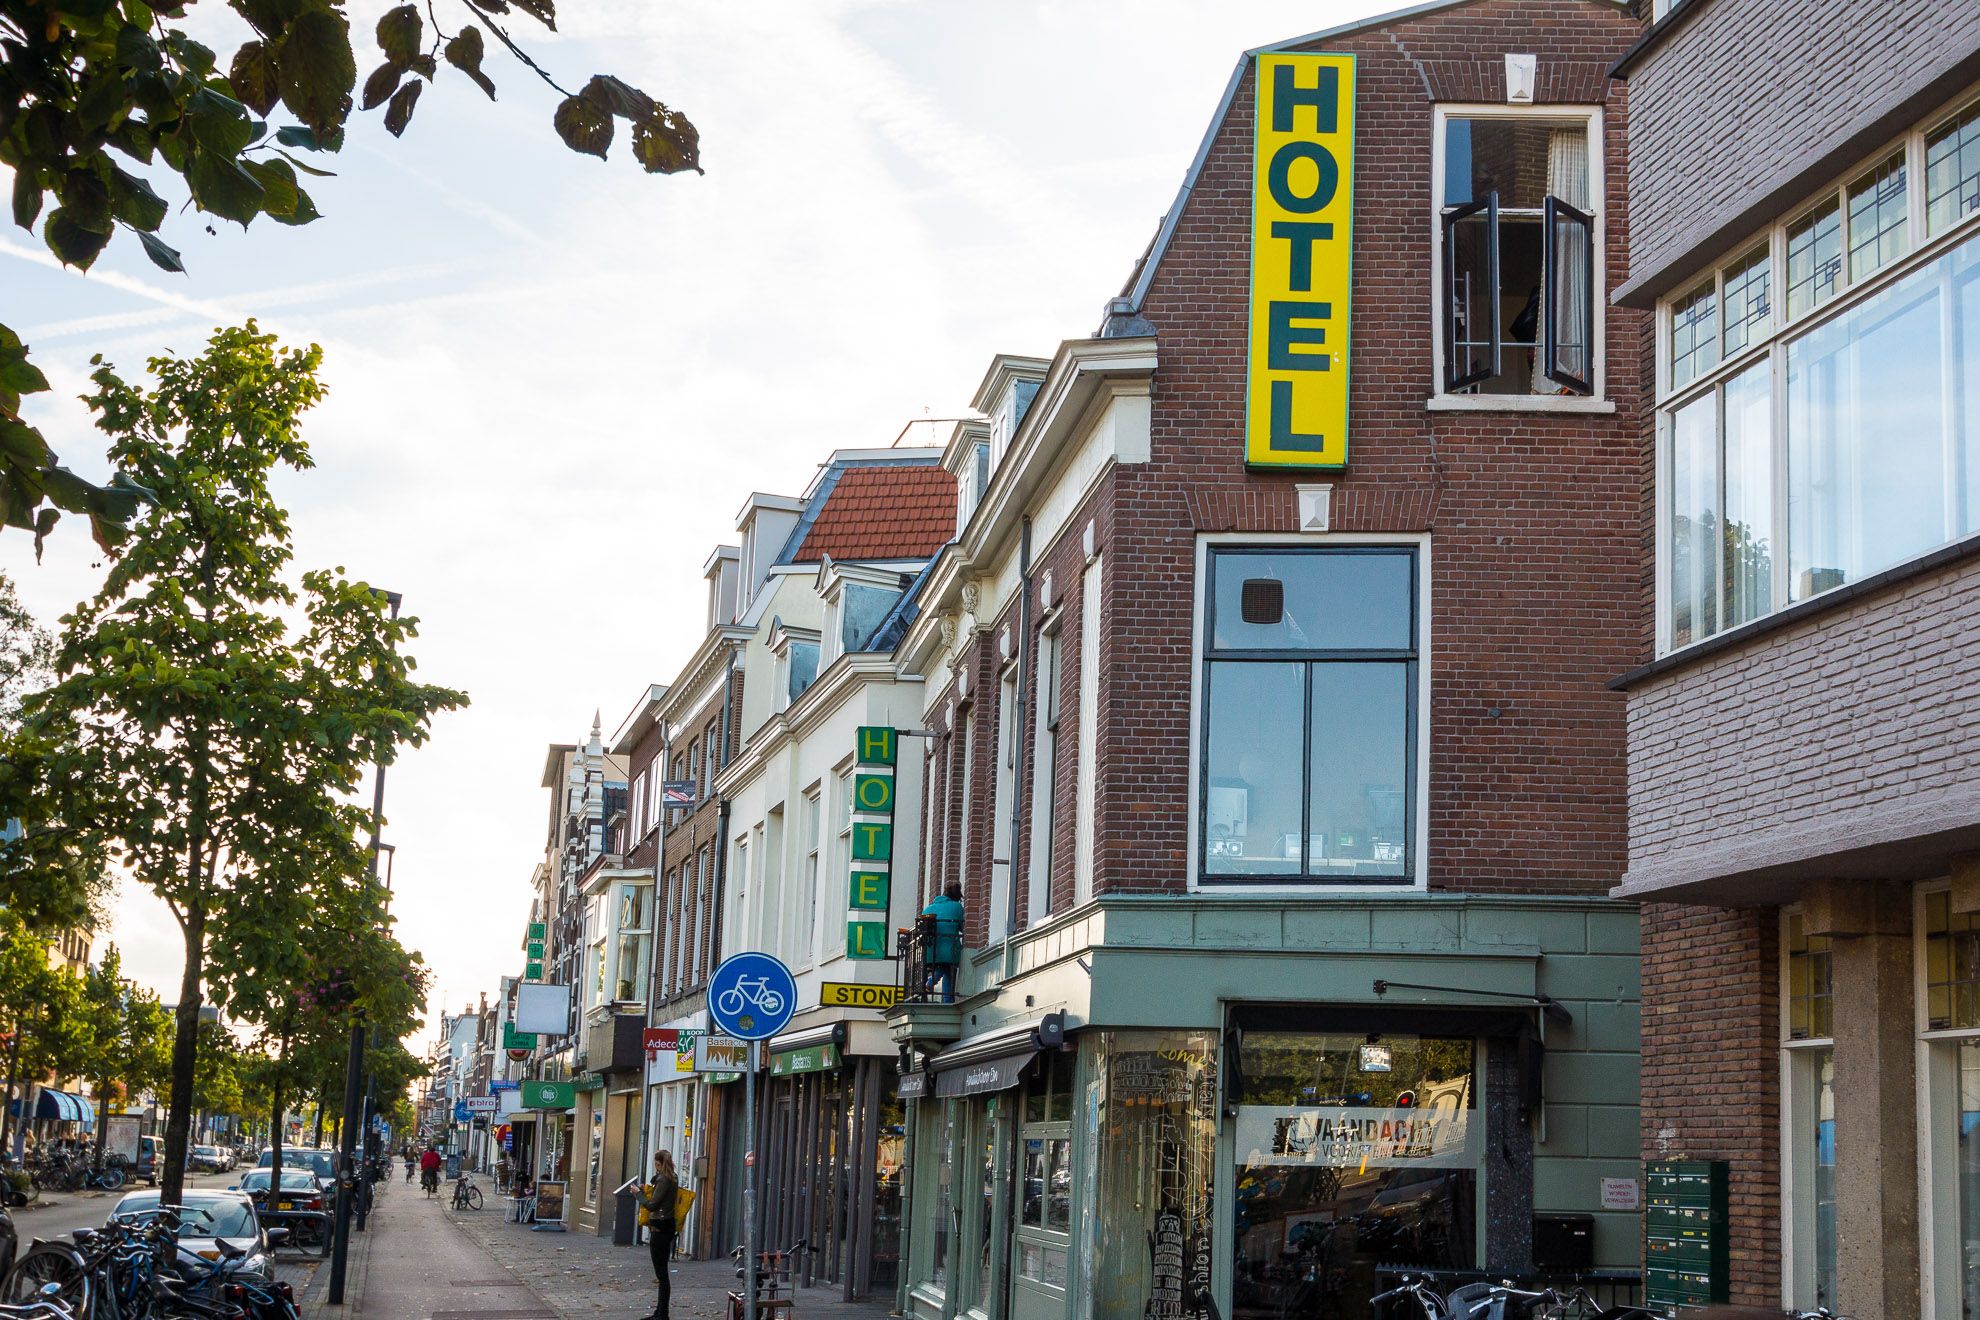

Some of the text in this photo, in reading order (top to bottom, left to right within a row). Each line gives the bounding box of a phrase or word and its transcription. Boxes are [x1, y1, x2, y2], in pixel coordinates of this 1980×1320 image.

[1268, 64, 1339, 453] HOTEL
[857, 729, 889, 955] HOTEL
[648, 1038, 679, 1049] Adecc
